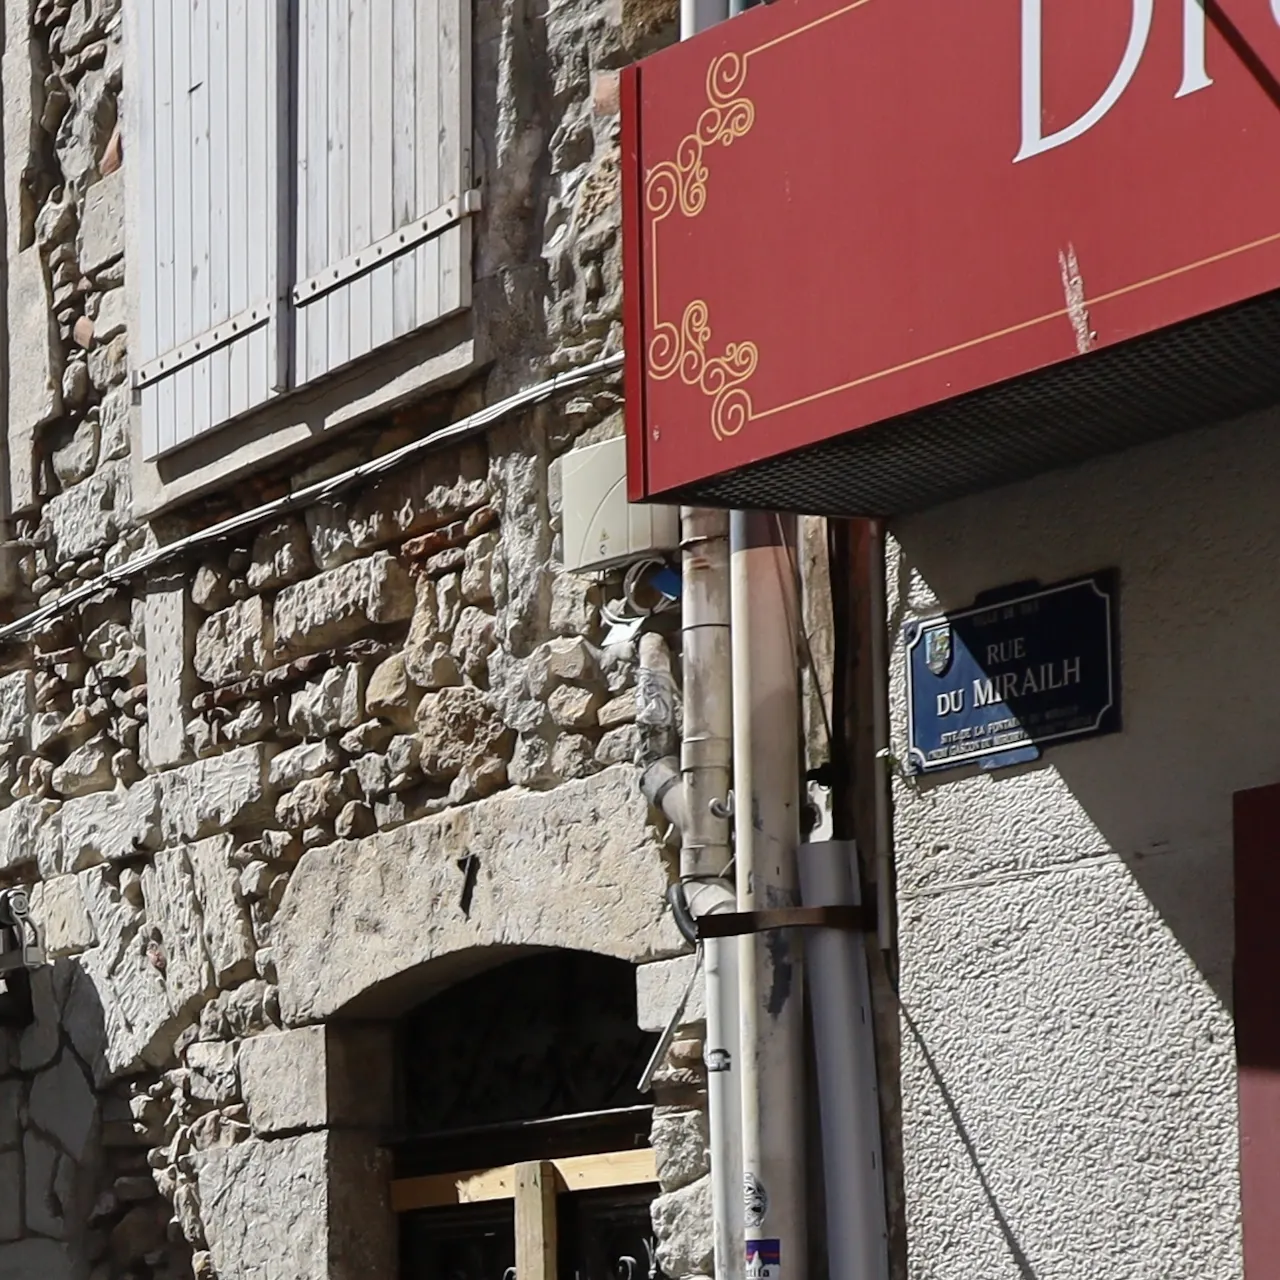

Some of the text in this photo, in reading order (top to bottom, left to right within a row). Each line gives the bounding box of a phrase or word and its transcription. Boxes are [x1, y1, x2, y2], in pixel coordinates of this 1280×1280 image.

[986, 637, 1026, 666] RUE
[937, 656, 1081, 717] DU MIRAILH
